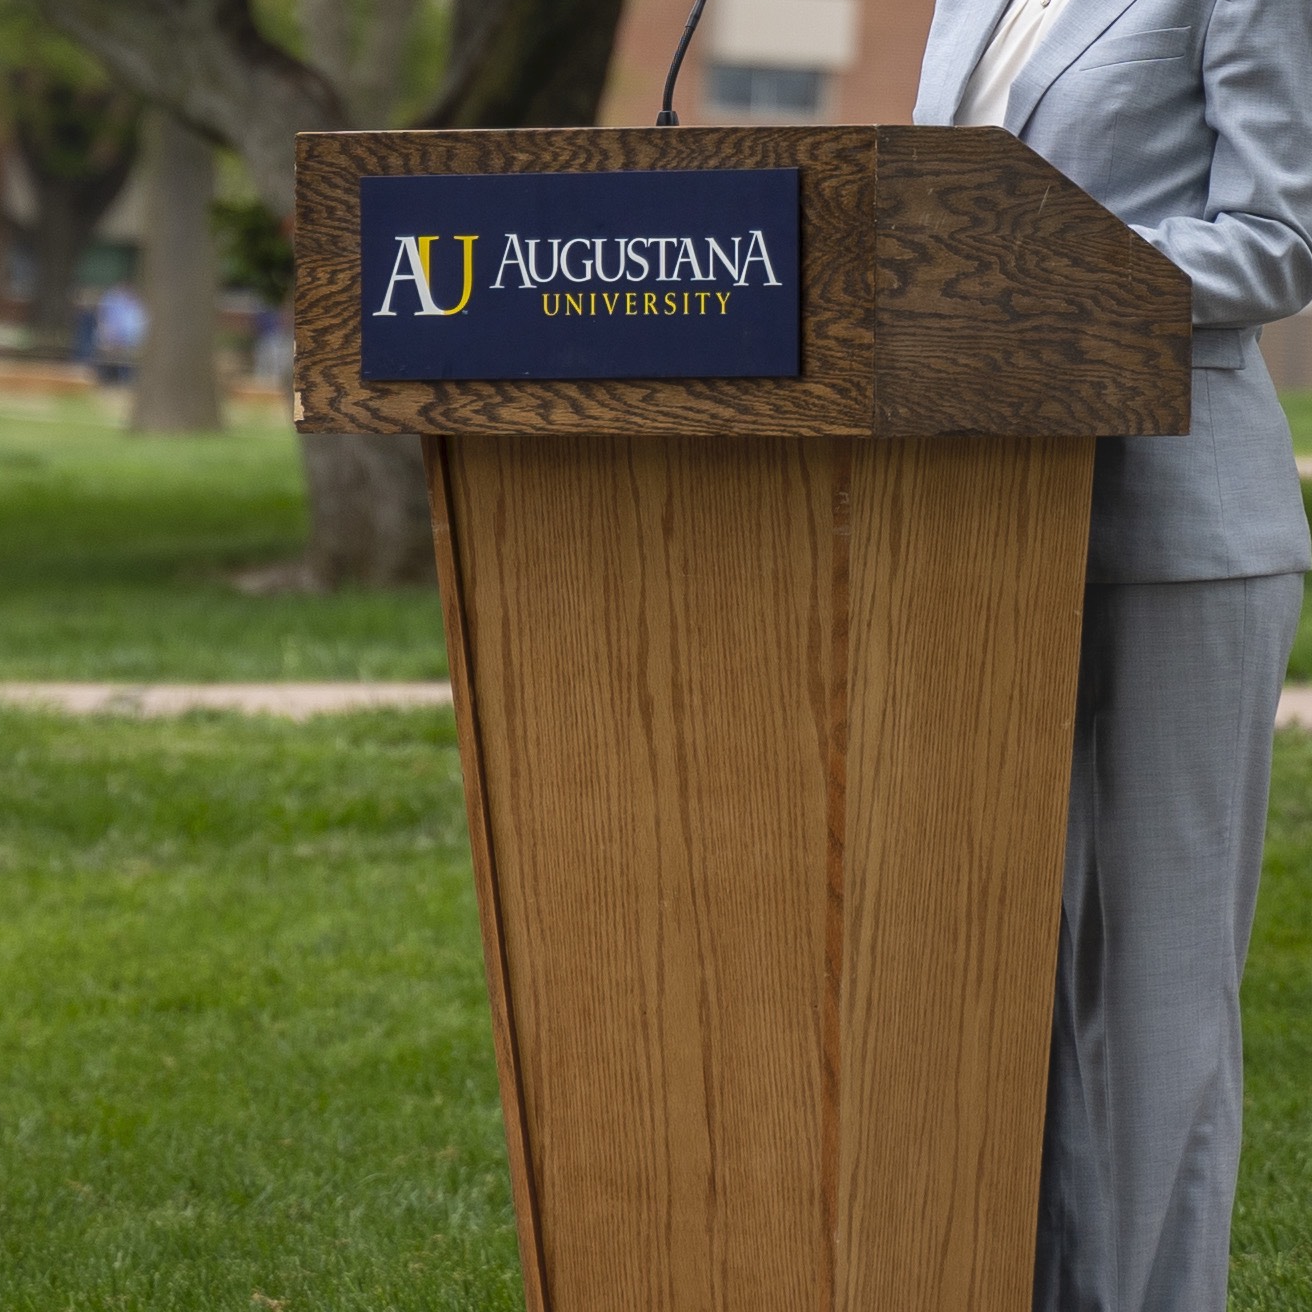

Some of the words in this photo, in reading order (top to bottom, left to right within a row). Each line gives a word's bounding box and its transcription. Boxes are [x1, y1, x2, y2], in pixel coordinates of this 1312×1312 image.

[372, 235, 480, 317] AU
[489, 230, 783, 289] AUGUSTANA
[541, 291, 731, 317] UNIVERSITY
